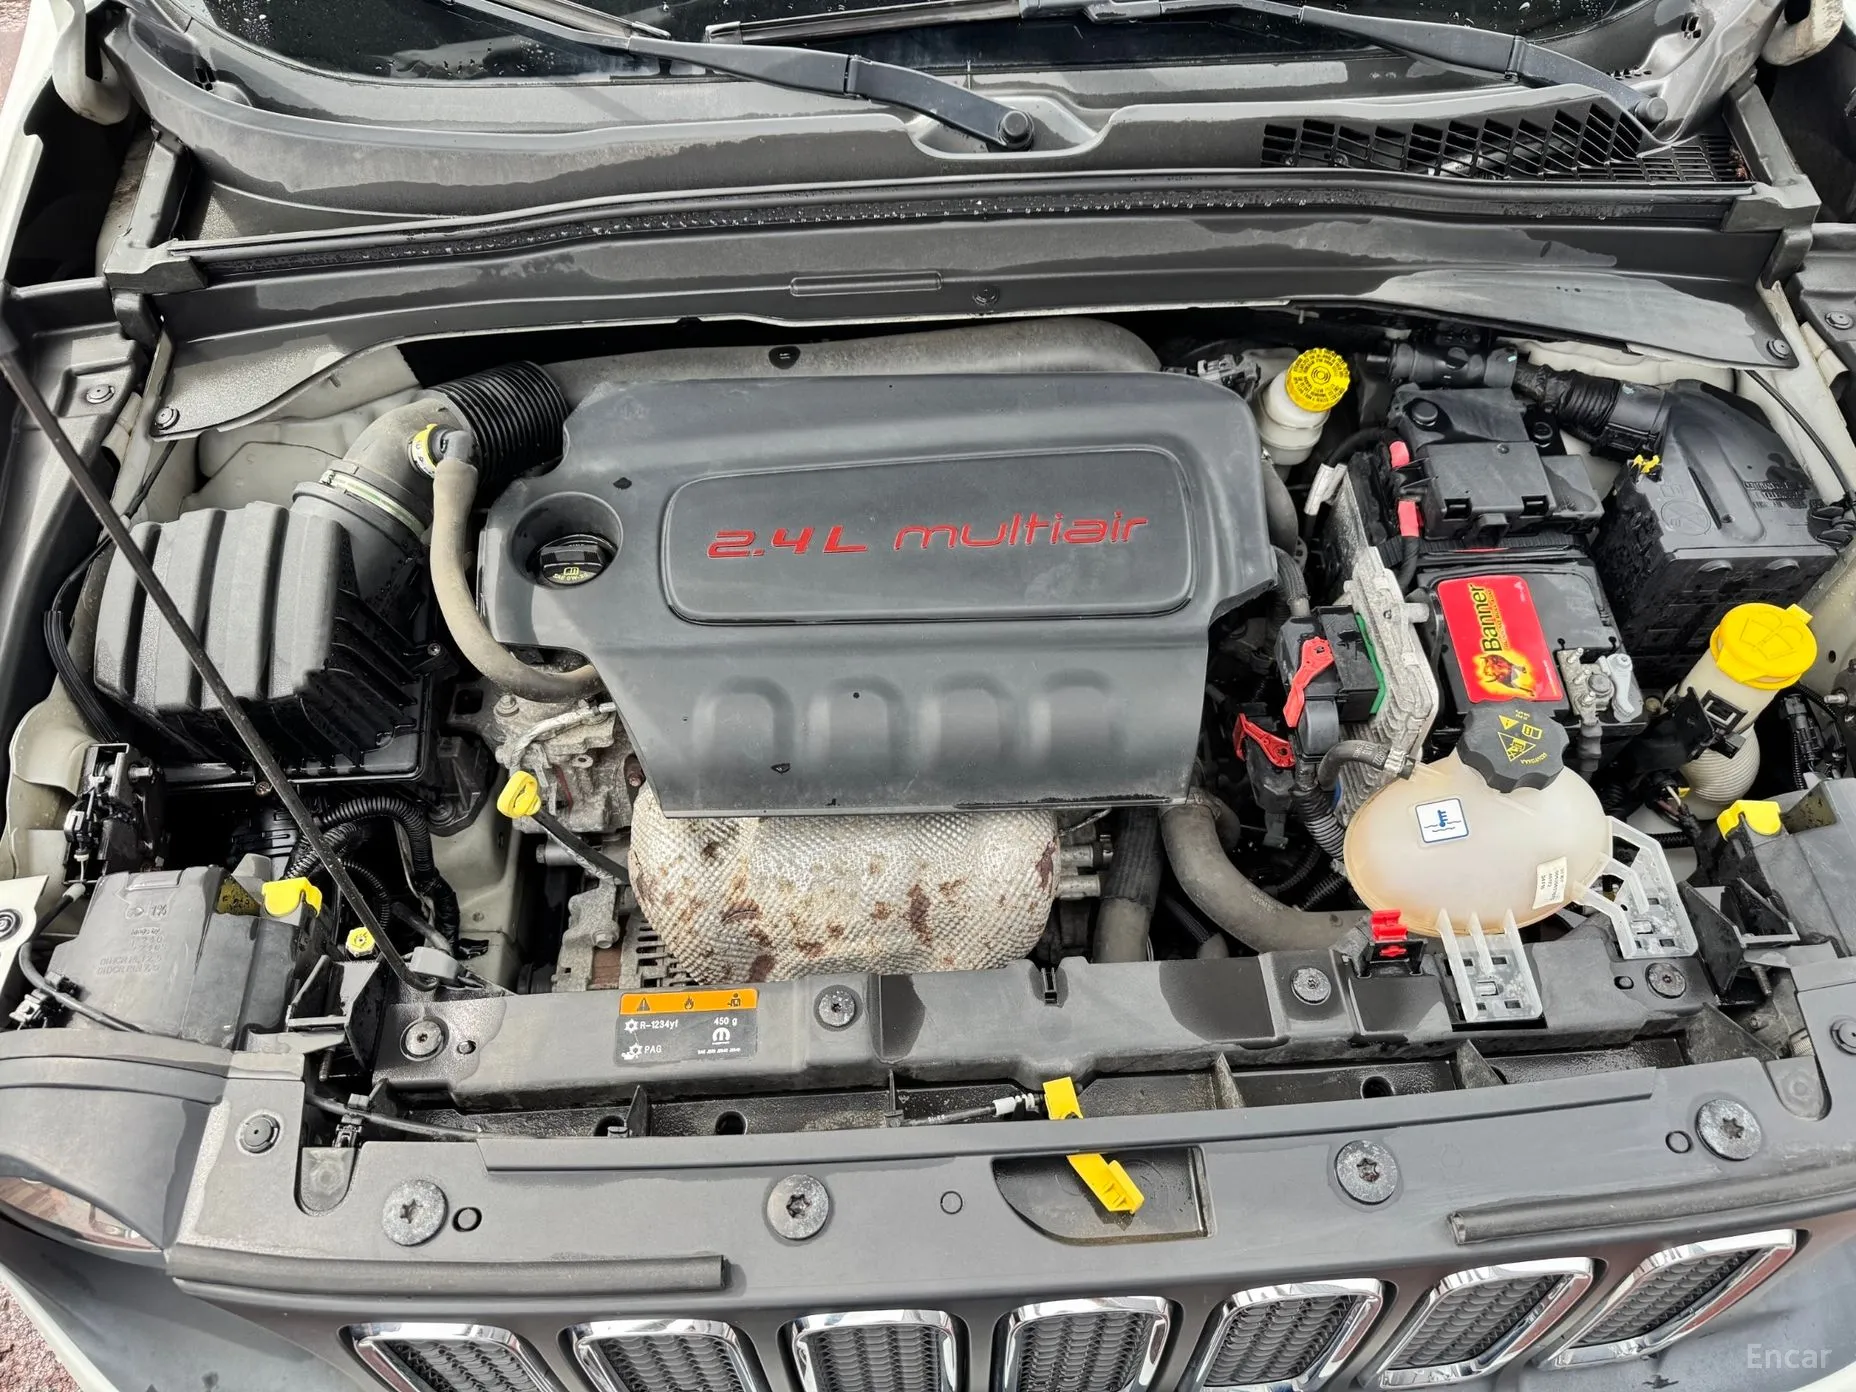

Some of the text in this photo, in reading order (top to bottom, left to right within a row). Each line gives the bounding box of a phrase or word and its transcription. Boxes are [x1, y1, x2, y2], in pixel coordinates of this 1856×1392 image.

[894, 511, 1148, 549] multiair
[1469, 583, 1503, 652] Banner
[640, 1019, 679, 1030] R-1234yf
[713, 1017, 738, 1026] 450 g
[644, 1045, 662, 1054] PAG
